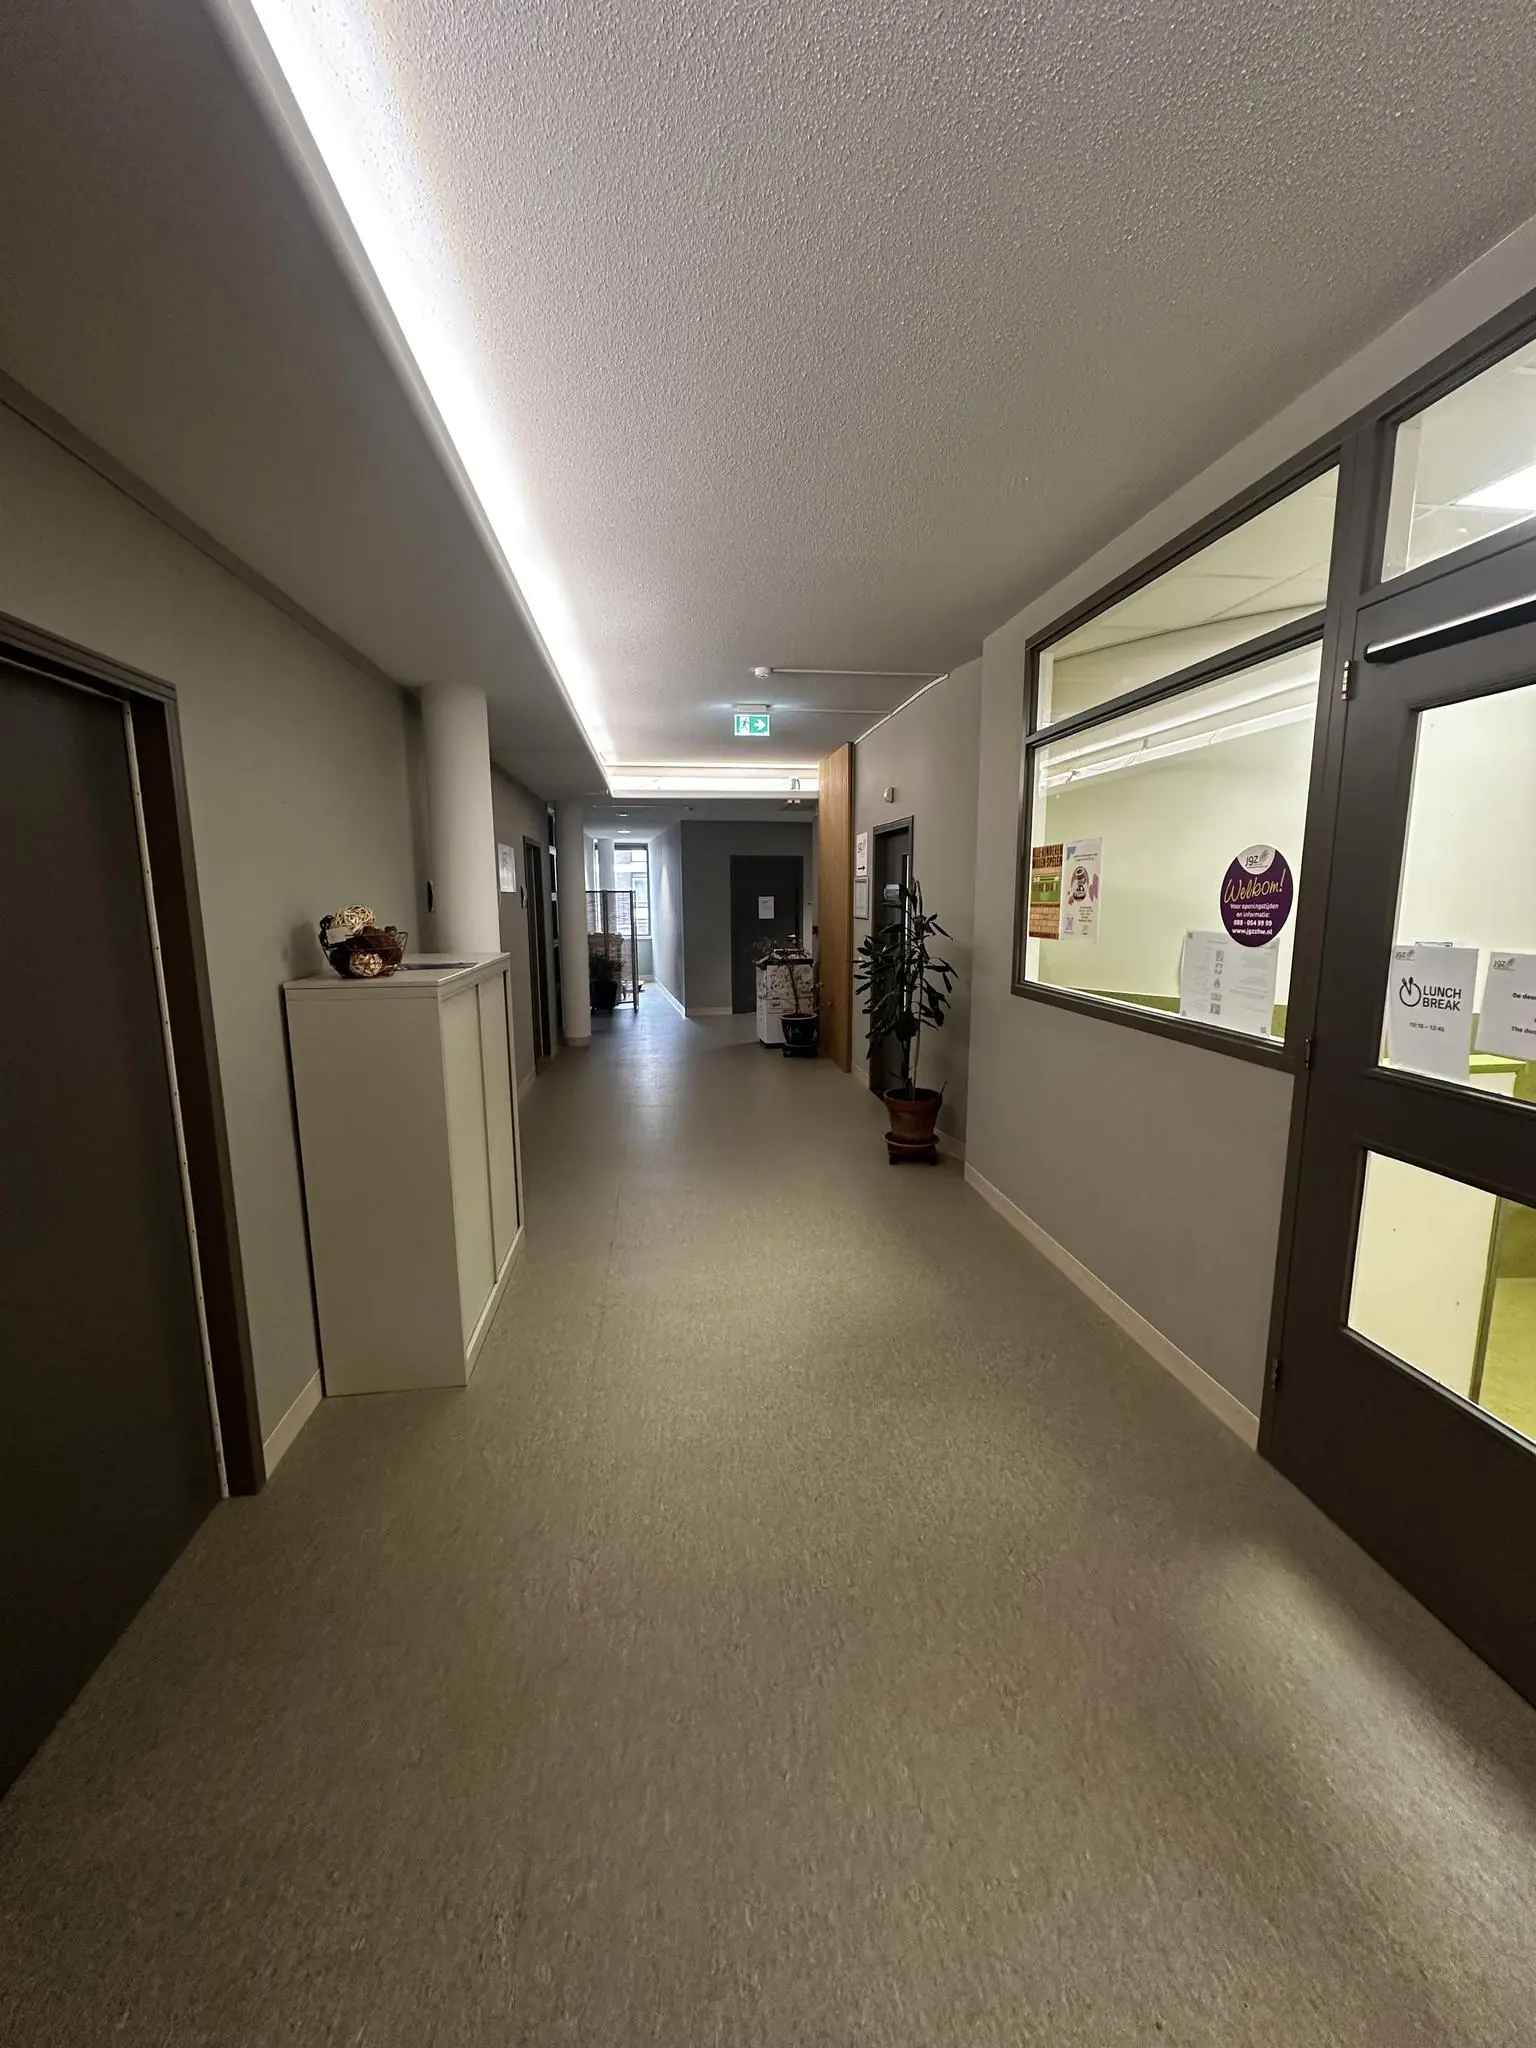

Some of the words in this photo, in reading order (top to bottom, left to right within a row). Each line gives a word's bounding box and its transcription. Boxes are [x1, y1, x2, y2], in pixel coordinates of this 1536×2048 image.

[1245, 856, 1258, 866] jgz
[1224, 868, 1286, 903] Welkom!
[1241, 902, 1279, 910] openingstijden
[1257, 919, 1264, 927] 99
[1423, 985, 1462, 1000] LUNCH
[1423, 997, 1461, 1011] BREAK
